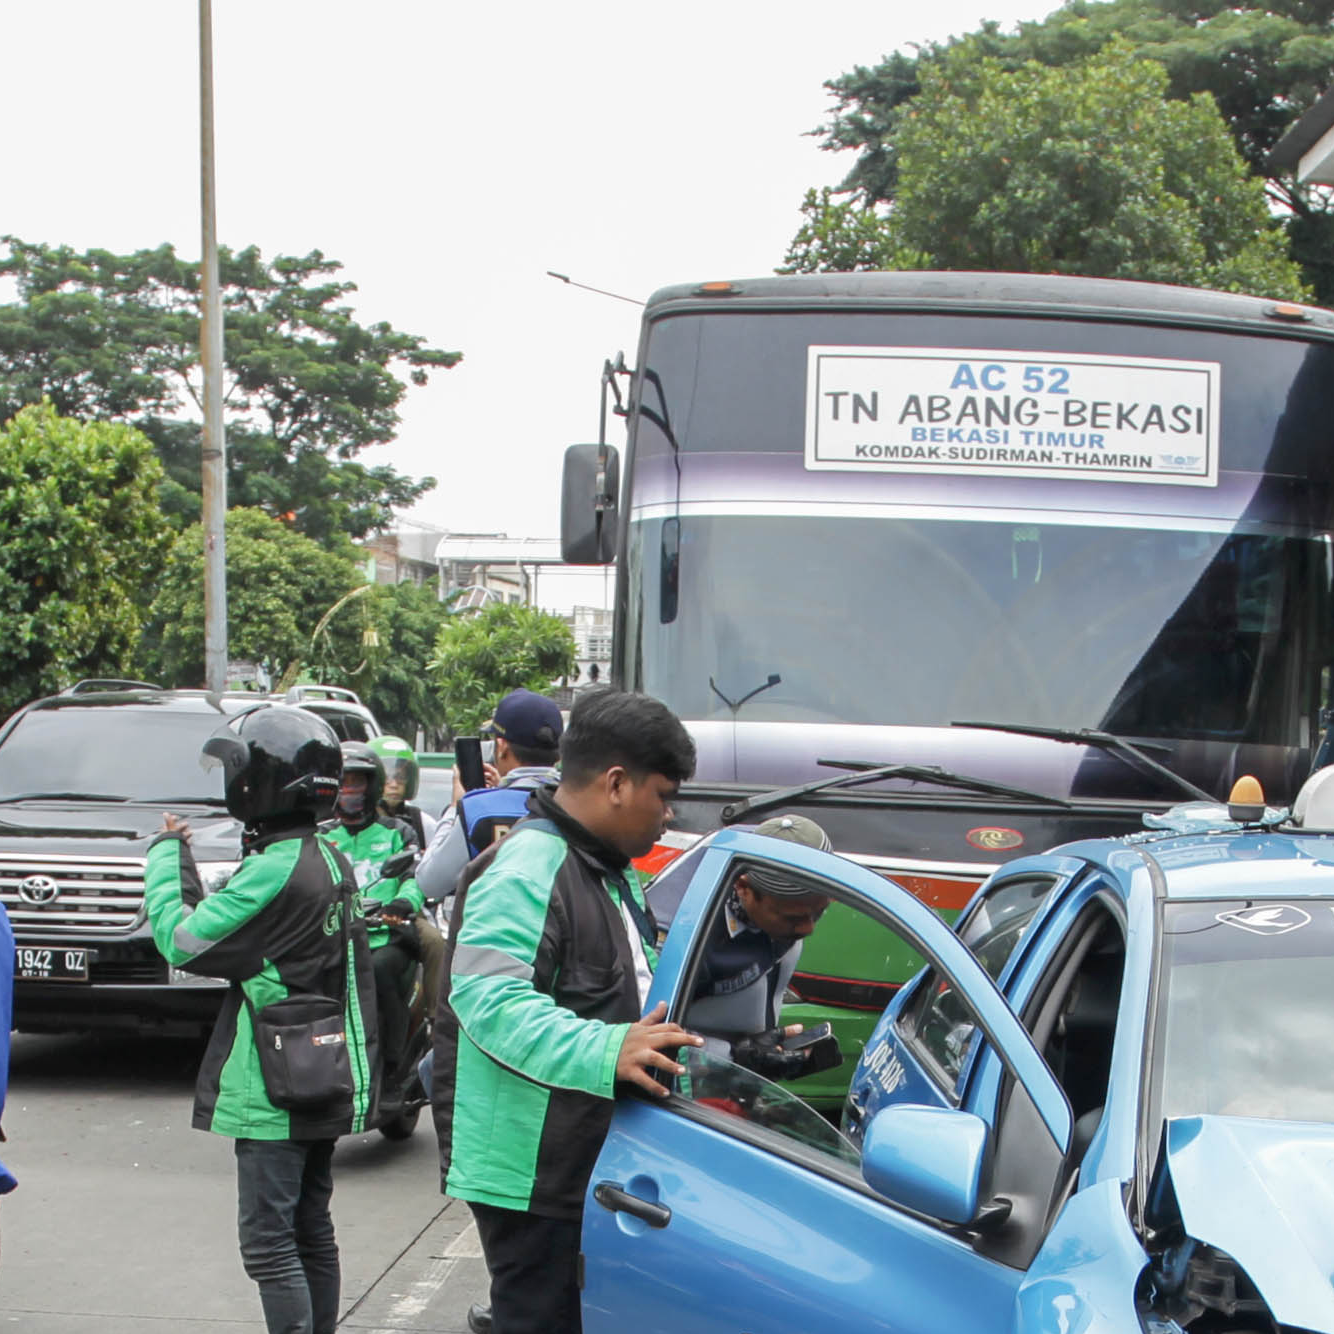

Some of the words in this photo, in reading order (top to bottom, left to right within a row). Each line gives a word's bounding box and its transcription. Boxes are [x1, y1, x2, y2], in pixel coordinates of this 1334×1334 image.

[950, 363, 1007, 392] AC
[1022, 366, 1070, 395] 52
[824, 390, 879, 424] TN
[898, 394, 1204, 435] ABANG-BEKASI
[911, 426, 1010, 446] BEKASI
[1020, 430, 1106, 449] TIMUR
[855, 443, 1153, 469] KOMDAK-SUDIRMAN-THAMRIN
[16, 949, 52, 970] 1942
